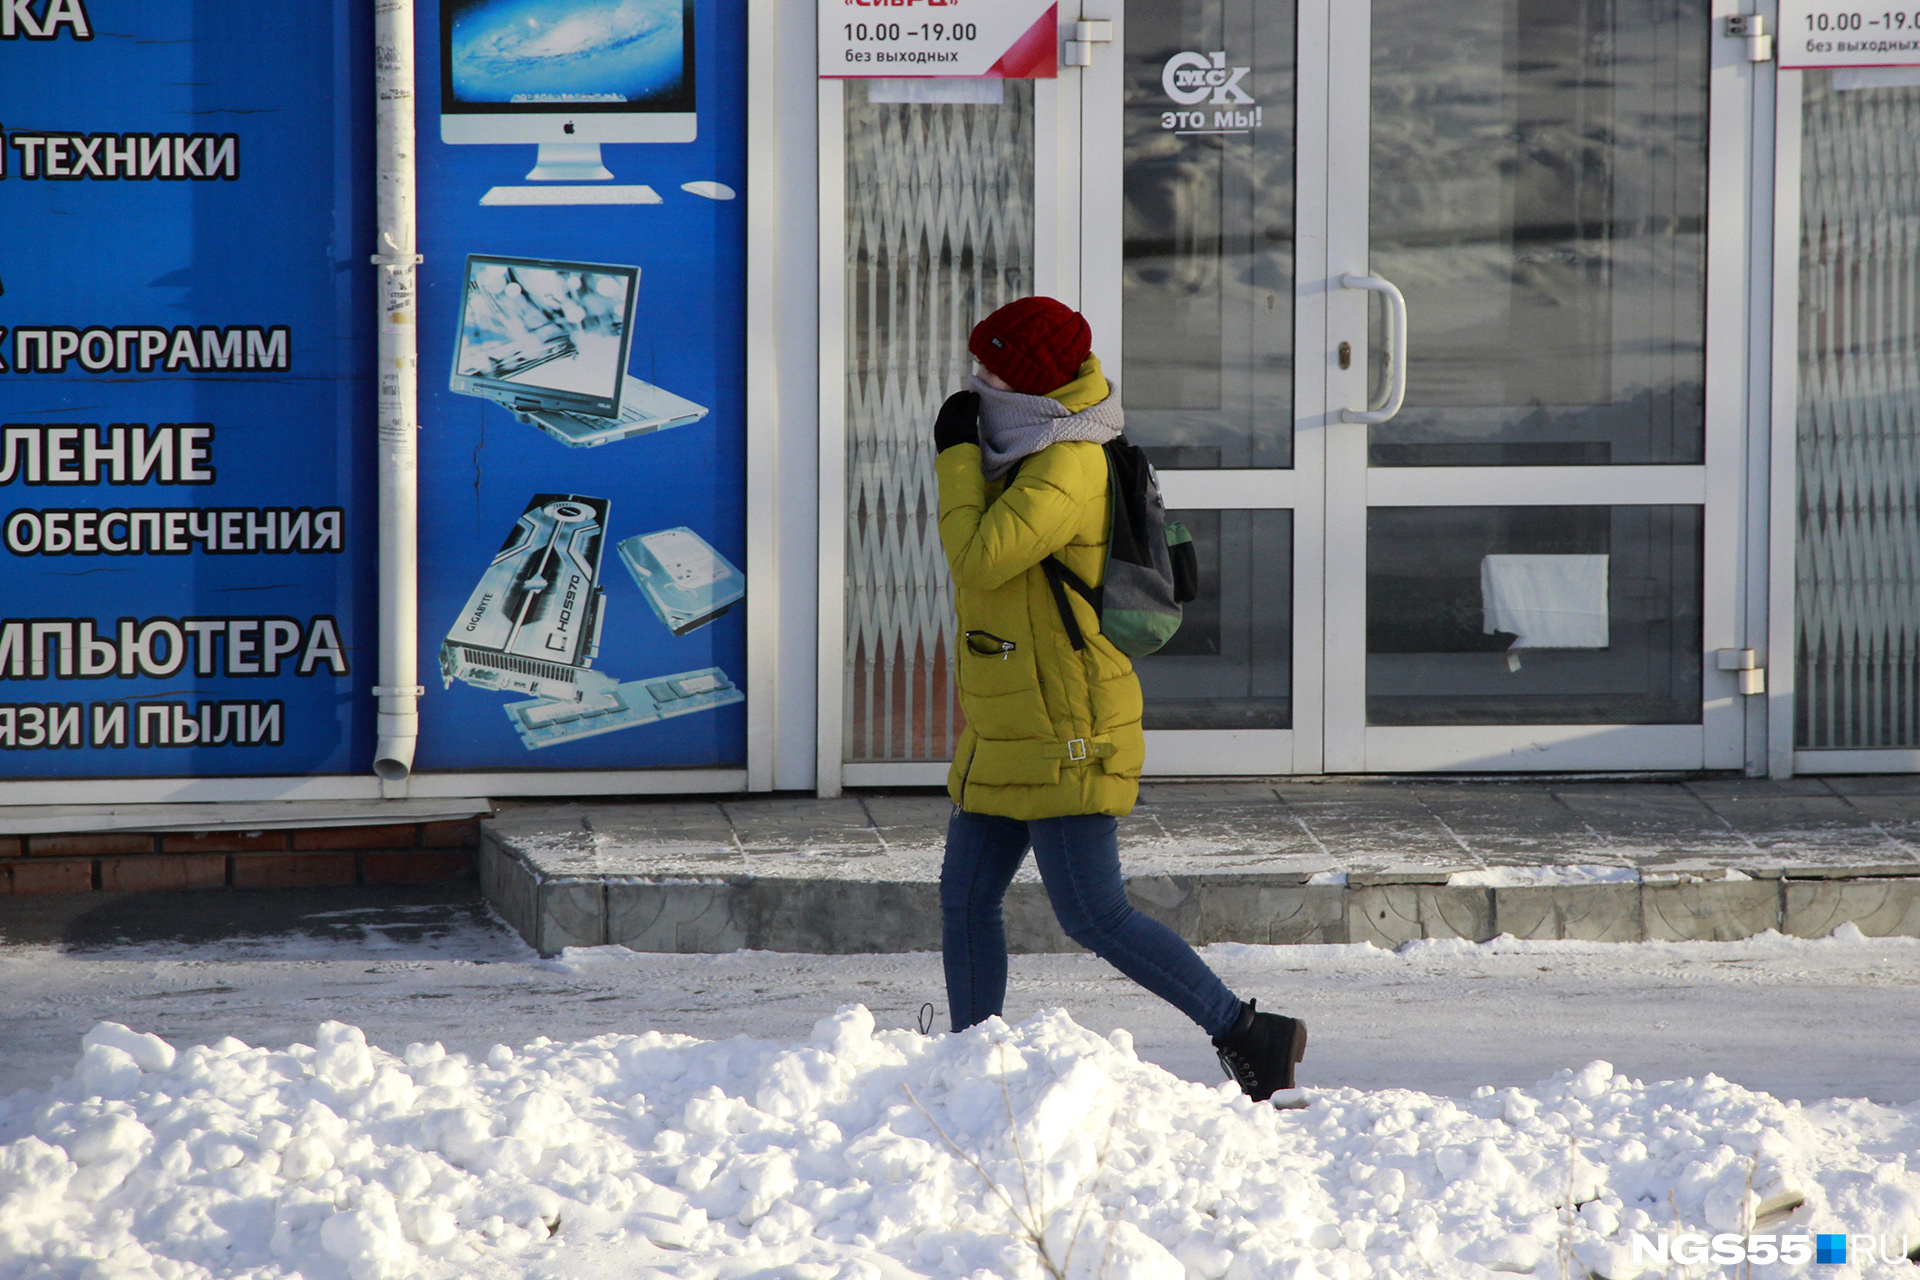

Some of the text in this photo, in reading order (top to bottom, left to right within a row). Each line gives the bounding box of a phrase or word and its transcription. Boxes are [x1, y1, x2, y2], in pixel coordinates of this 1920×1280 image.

[844, 23, 901, 42] 10.00
[1805, 13, 1863, 31] 10.00
[845, 49, 959, 64] без выходных
[1805, 39, 1920, 53] без выходных
[13, 134, 237, 178] ТЕХНИКИ
[15, 328, 289, 371] ПРОГРАММ
[6, 509, 342, 553] ОБЕСПЕЧЕНИЯ
[466, 592, 493, 632] GIGABYTE
[93, 704, 126, 746] И
[137, 702, 282, 745] ПЫЛИ
